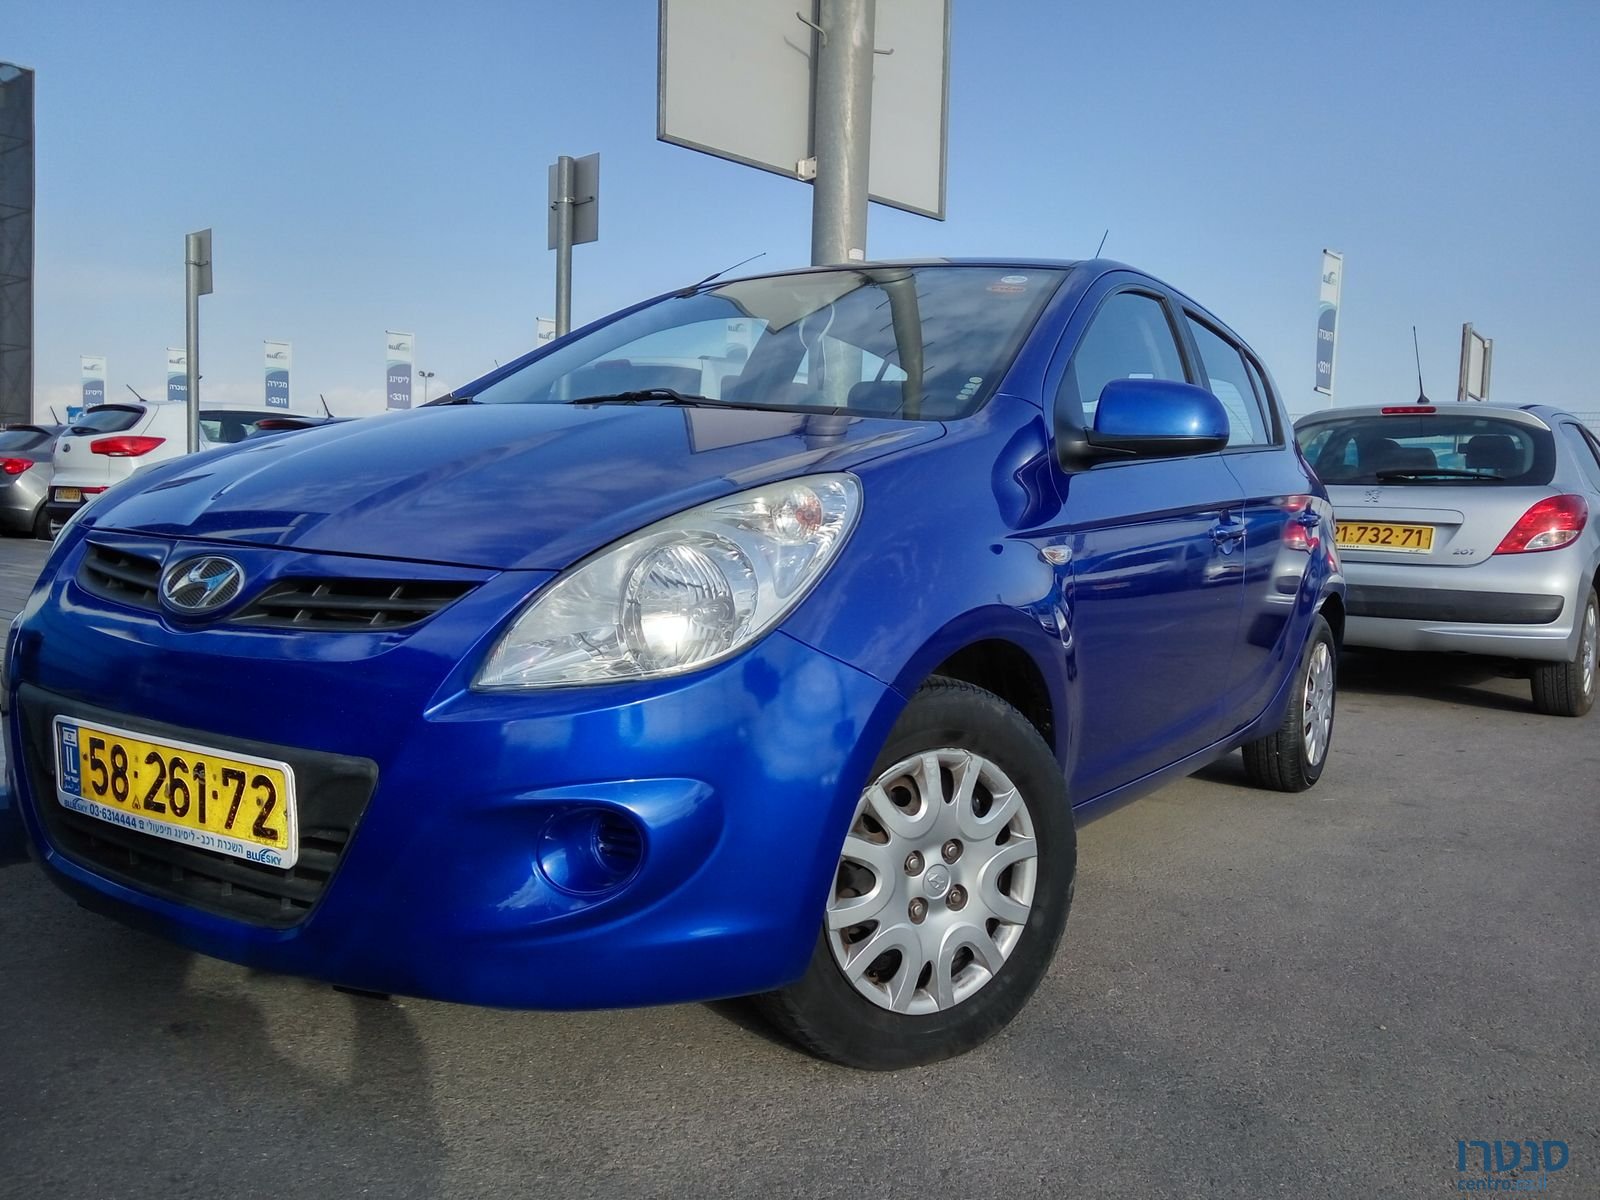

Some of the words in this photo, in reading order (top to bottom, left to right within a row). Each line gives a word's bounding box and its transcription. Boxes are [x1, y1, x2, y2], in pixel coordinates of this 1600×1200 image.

[267, 381, 288, 389] מכירה
[390, 376, 409, 384] ליסינג
[90, 803, 137, 828] 03-6314444
[146, 819, 172, 836] תיפעולי
[216, 839, 244, 854] השכרת
[246, 848, 282, 866] BLUESKY
